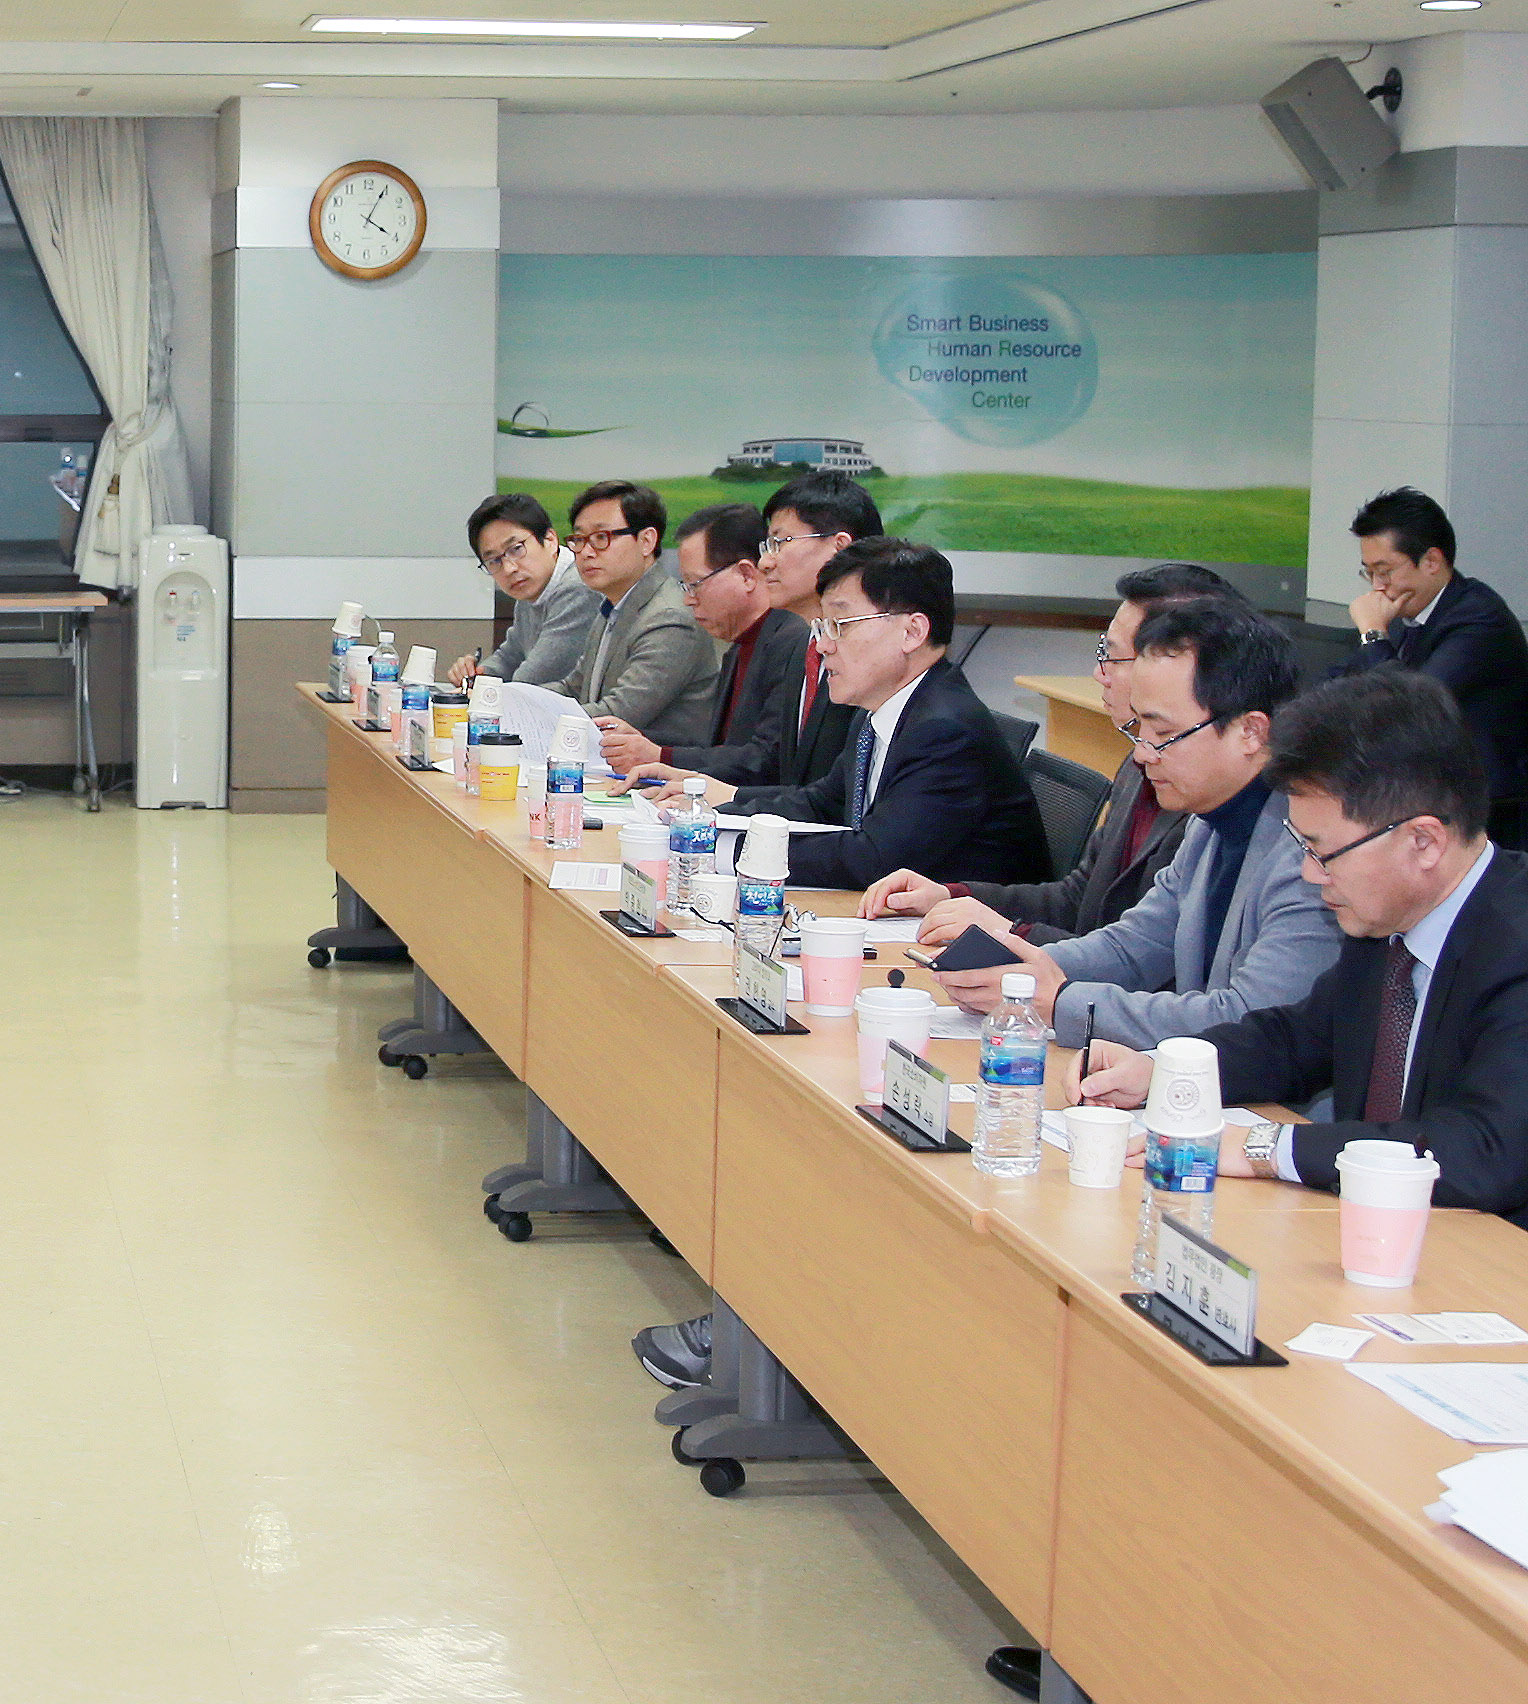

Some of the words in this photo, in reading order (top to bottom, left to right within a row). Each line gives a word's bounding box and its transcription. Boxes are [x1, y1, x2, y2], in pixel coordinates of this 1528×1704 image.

[907, 314, 961, 332] Smart
[969, 314, 1049, 332] Business
[928, 340, 992, 357] Human
[998, 339, 1082, 358] Resource
[909, 364, 1028, 385] Development
[971, 390, 1033, 408] Center
